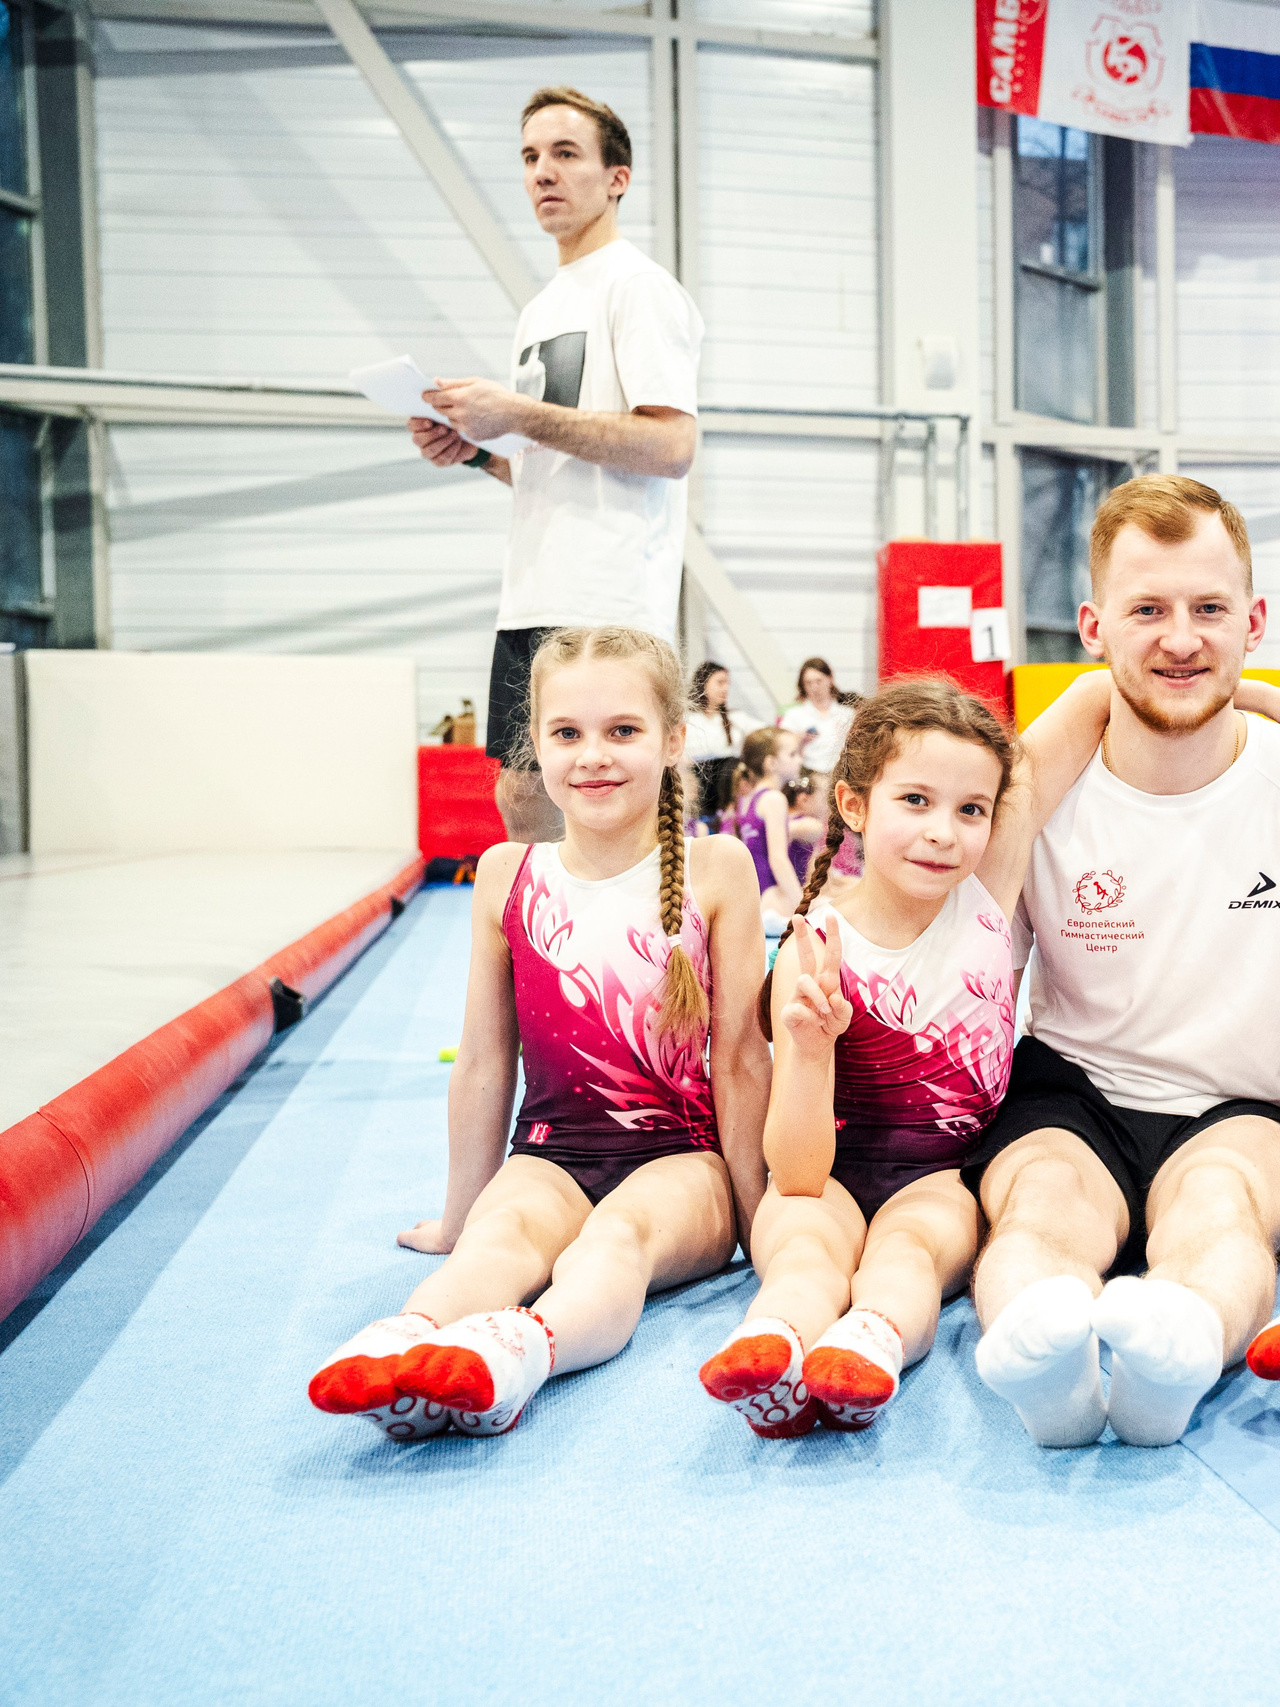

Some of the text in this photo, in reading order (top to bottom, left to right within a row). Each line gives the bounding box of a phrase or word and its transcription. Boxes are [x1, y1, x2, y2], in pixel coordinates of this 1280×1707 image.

[981, 625, 997, 659] 1
[1066, 918, 1136, 929] Европейский
[1060, 929, 1146, 940] Гимнастический
[1085, 942, 1118, 953] Центр
